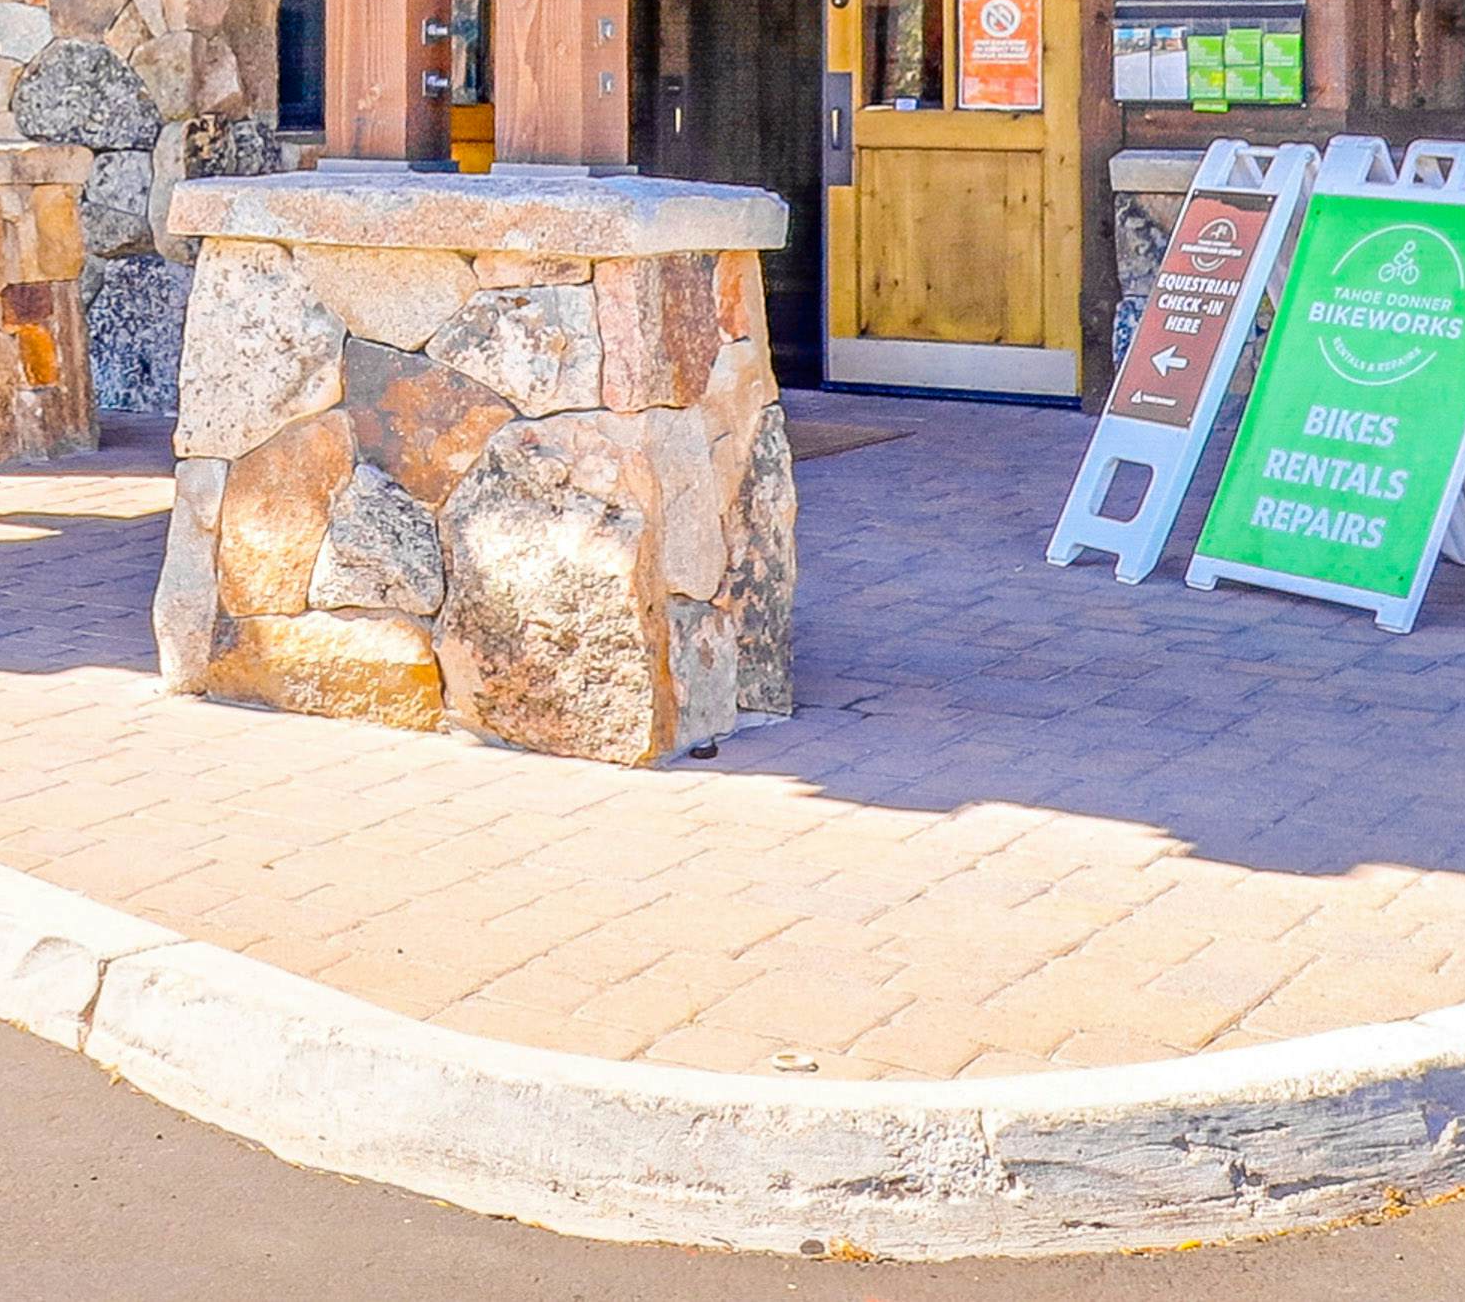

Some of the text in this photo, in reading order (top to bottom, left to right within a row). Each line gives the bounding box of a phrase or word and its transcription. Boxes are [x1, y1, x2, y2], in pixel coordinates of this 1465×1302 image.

[1157, 274, 1240, 296] EQUESTRIAN
[1333, 286, 1452, 312] TAHOE DONNER
[1165, 315, 1202, 334] HERE
[1308, 300, 1465, 340] BIKEWORKS
[1303, 403, 1400, 448] BIKES
[1262, 446, 1410, 500] RENTALS
[1250, 494, 1387, 549] REPAIRS
